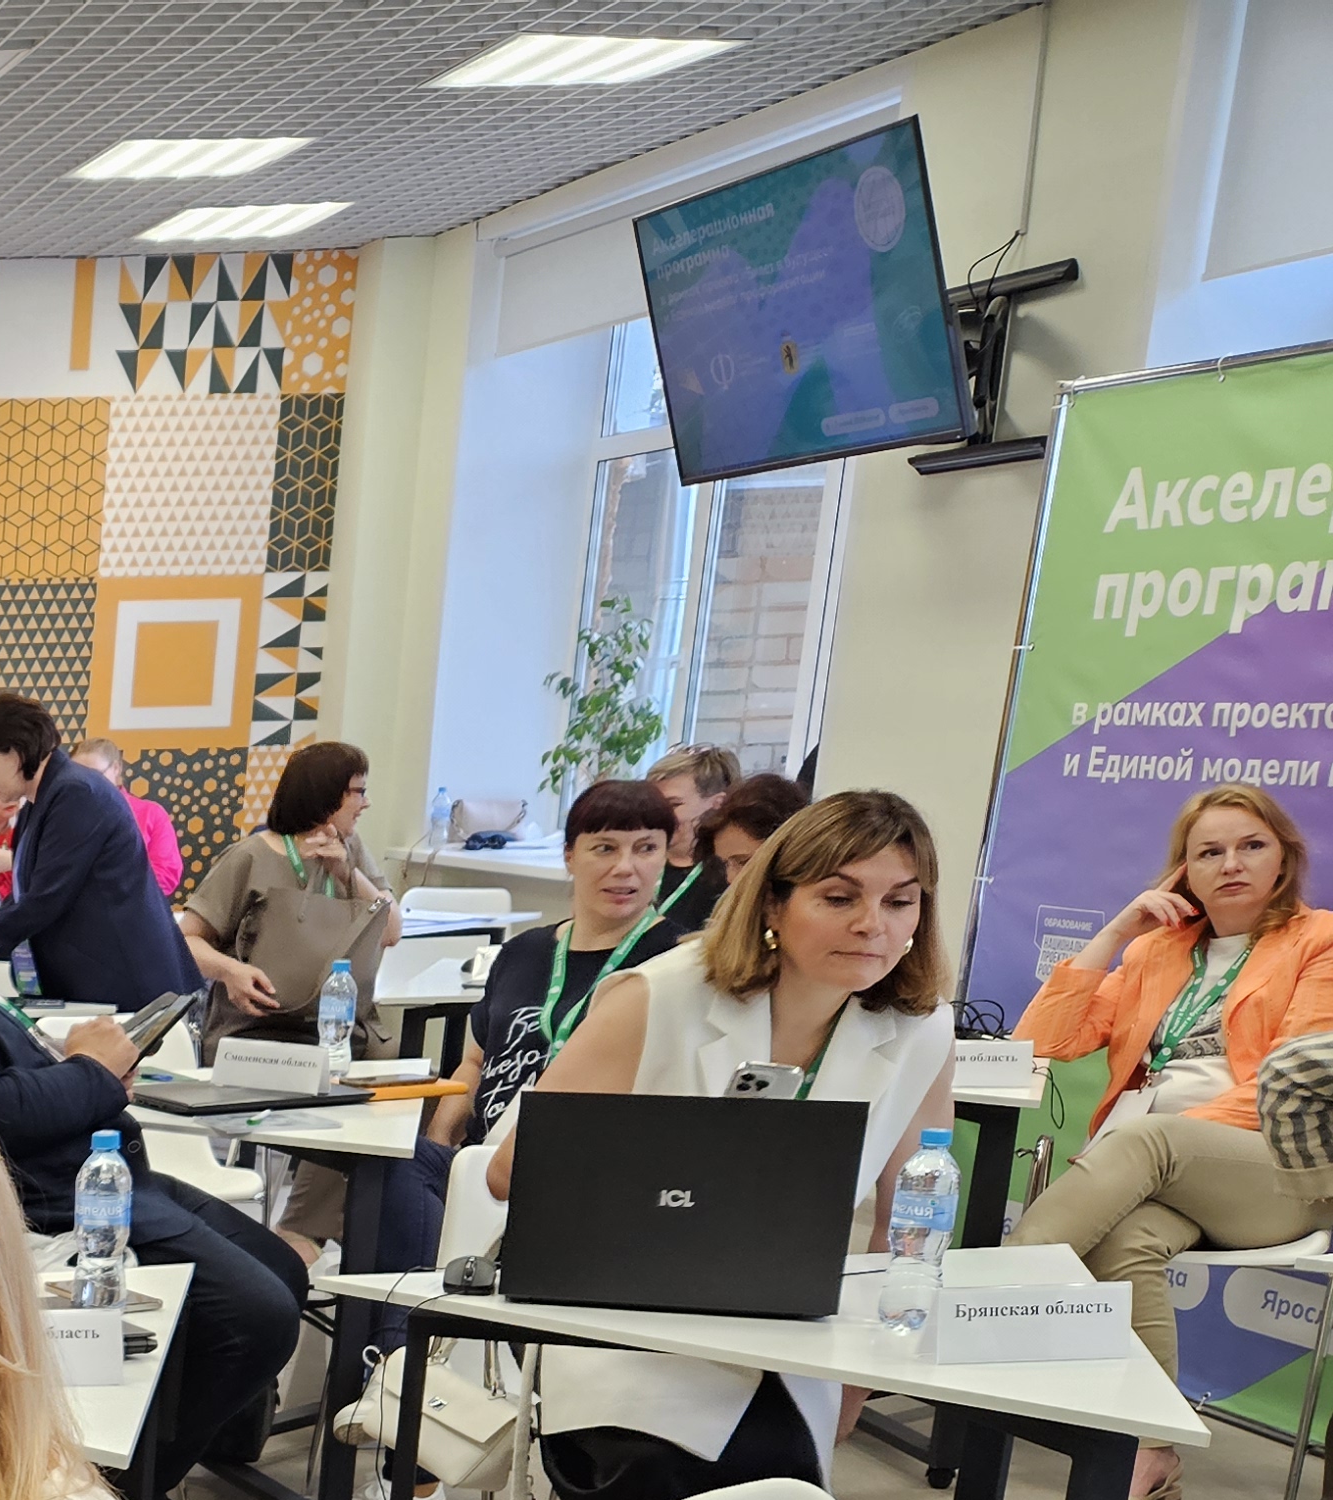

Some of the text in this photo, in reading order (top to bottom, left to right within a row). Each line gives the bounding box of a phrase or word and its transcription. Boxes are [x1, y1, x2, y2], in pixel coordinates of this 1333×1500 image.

[1102, 462, 1333, 534] Акселе
[1071, 702, 1088, 726] в
[1093, 701, 1206, 735] рамках
[1063, 753, 1080, 778] и
[1087, 746, 1194, 784] Единой
[1201, 757, 1320, 789] модели
[1044, 917, 1094, 932] ОБРАЗОВАНИЕ
[223, 1051, 318, 1068] Смоленская область
[969, 1052, 1018, 1063] область
[657, 1189, 695, 1207] ICL
[78, 1204, 123, 1218] апелия
[1165, 1268, 1188, 1288] да
[955, 1300, 1113, 1321] Брянская область
[45, 1326, 101, 1341] бласть
